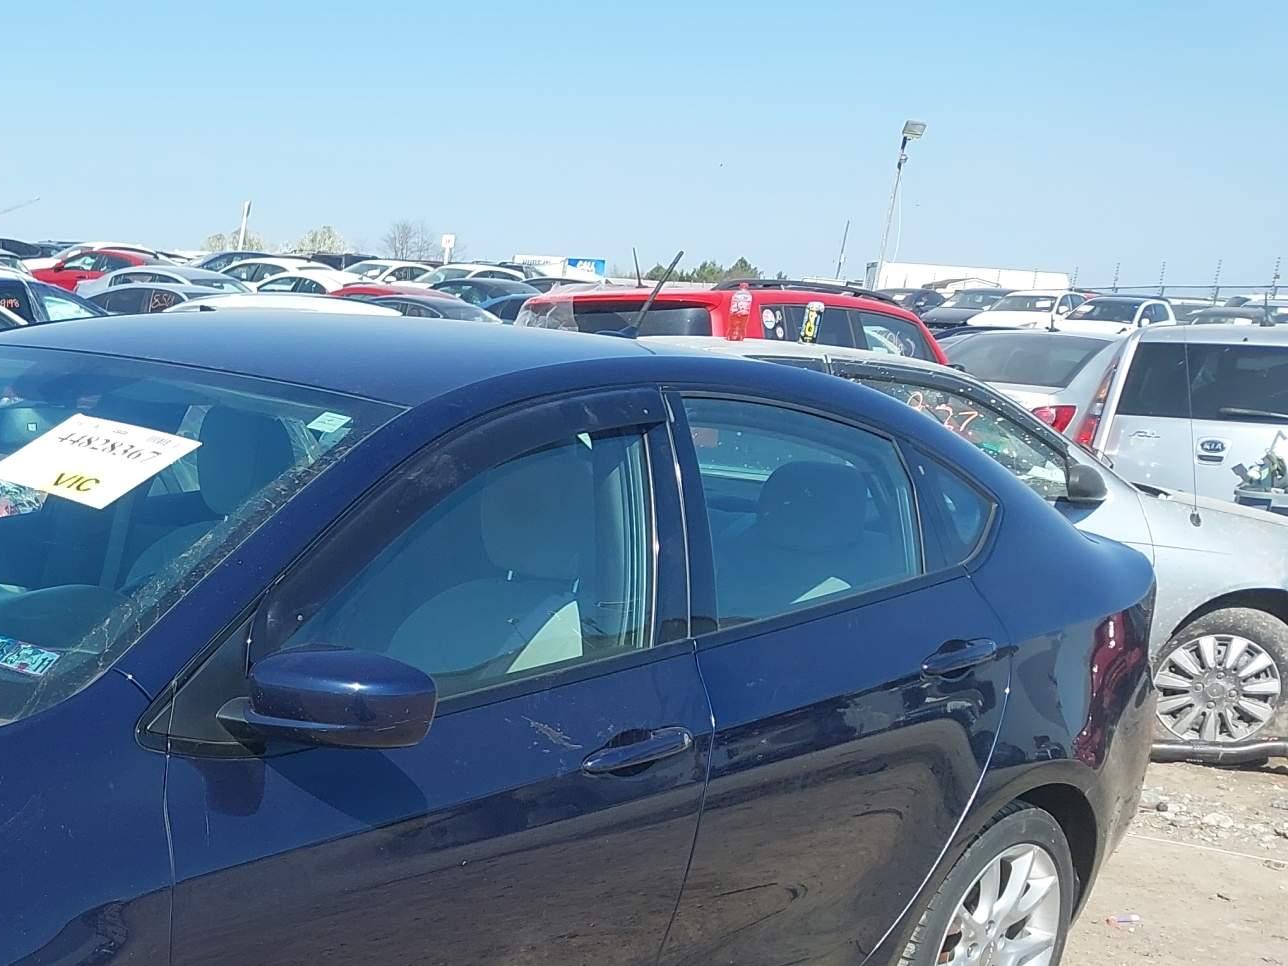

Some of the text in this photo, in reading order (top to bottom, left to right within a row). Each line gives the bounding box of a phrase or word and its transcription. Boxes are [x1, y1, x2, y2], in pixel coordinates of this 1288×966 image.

[57, 432, 163, 463] 44828367
[1202, 442, 1223, 451] KIA
[53, 472, 101, 492] VIC
